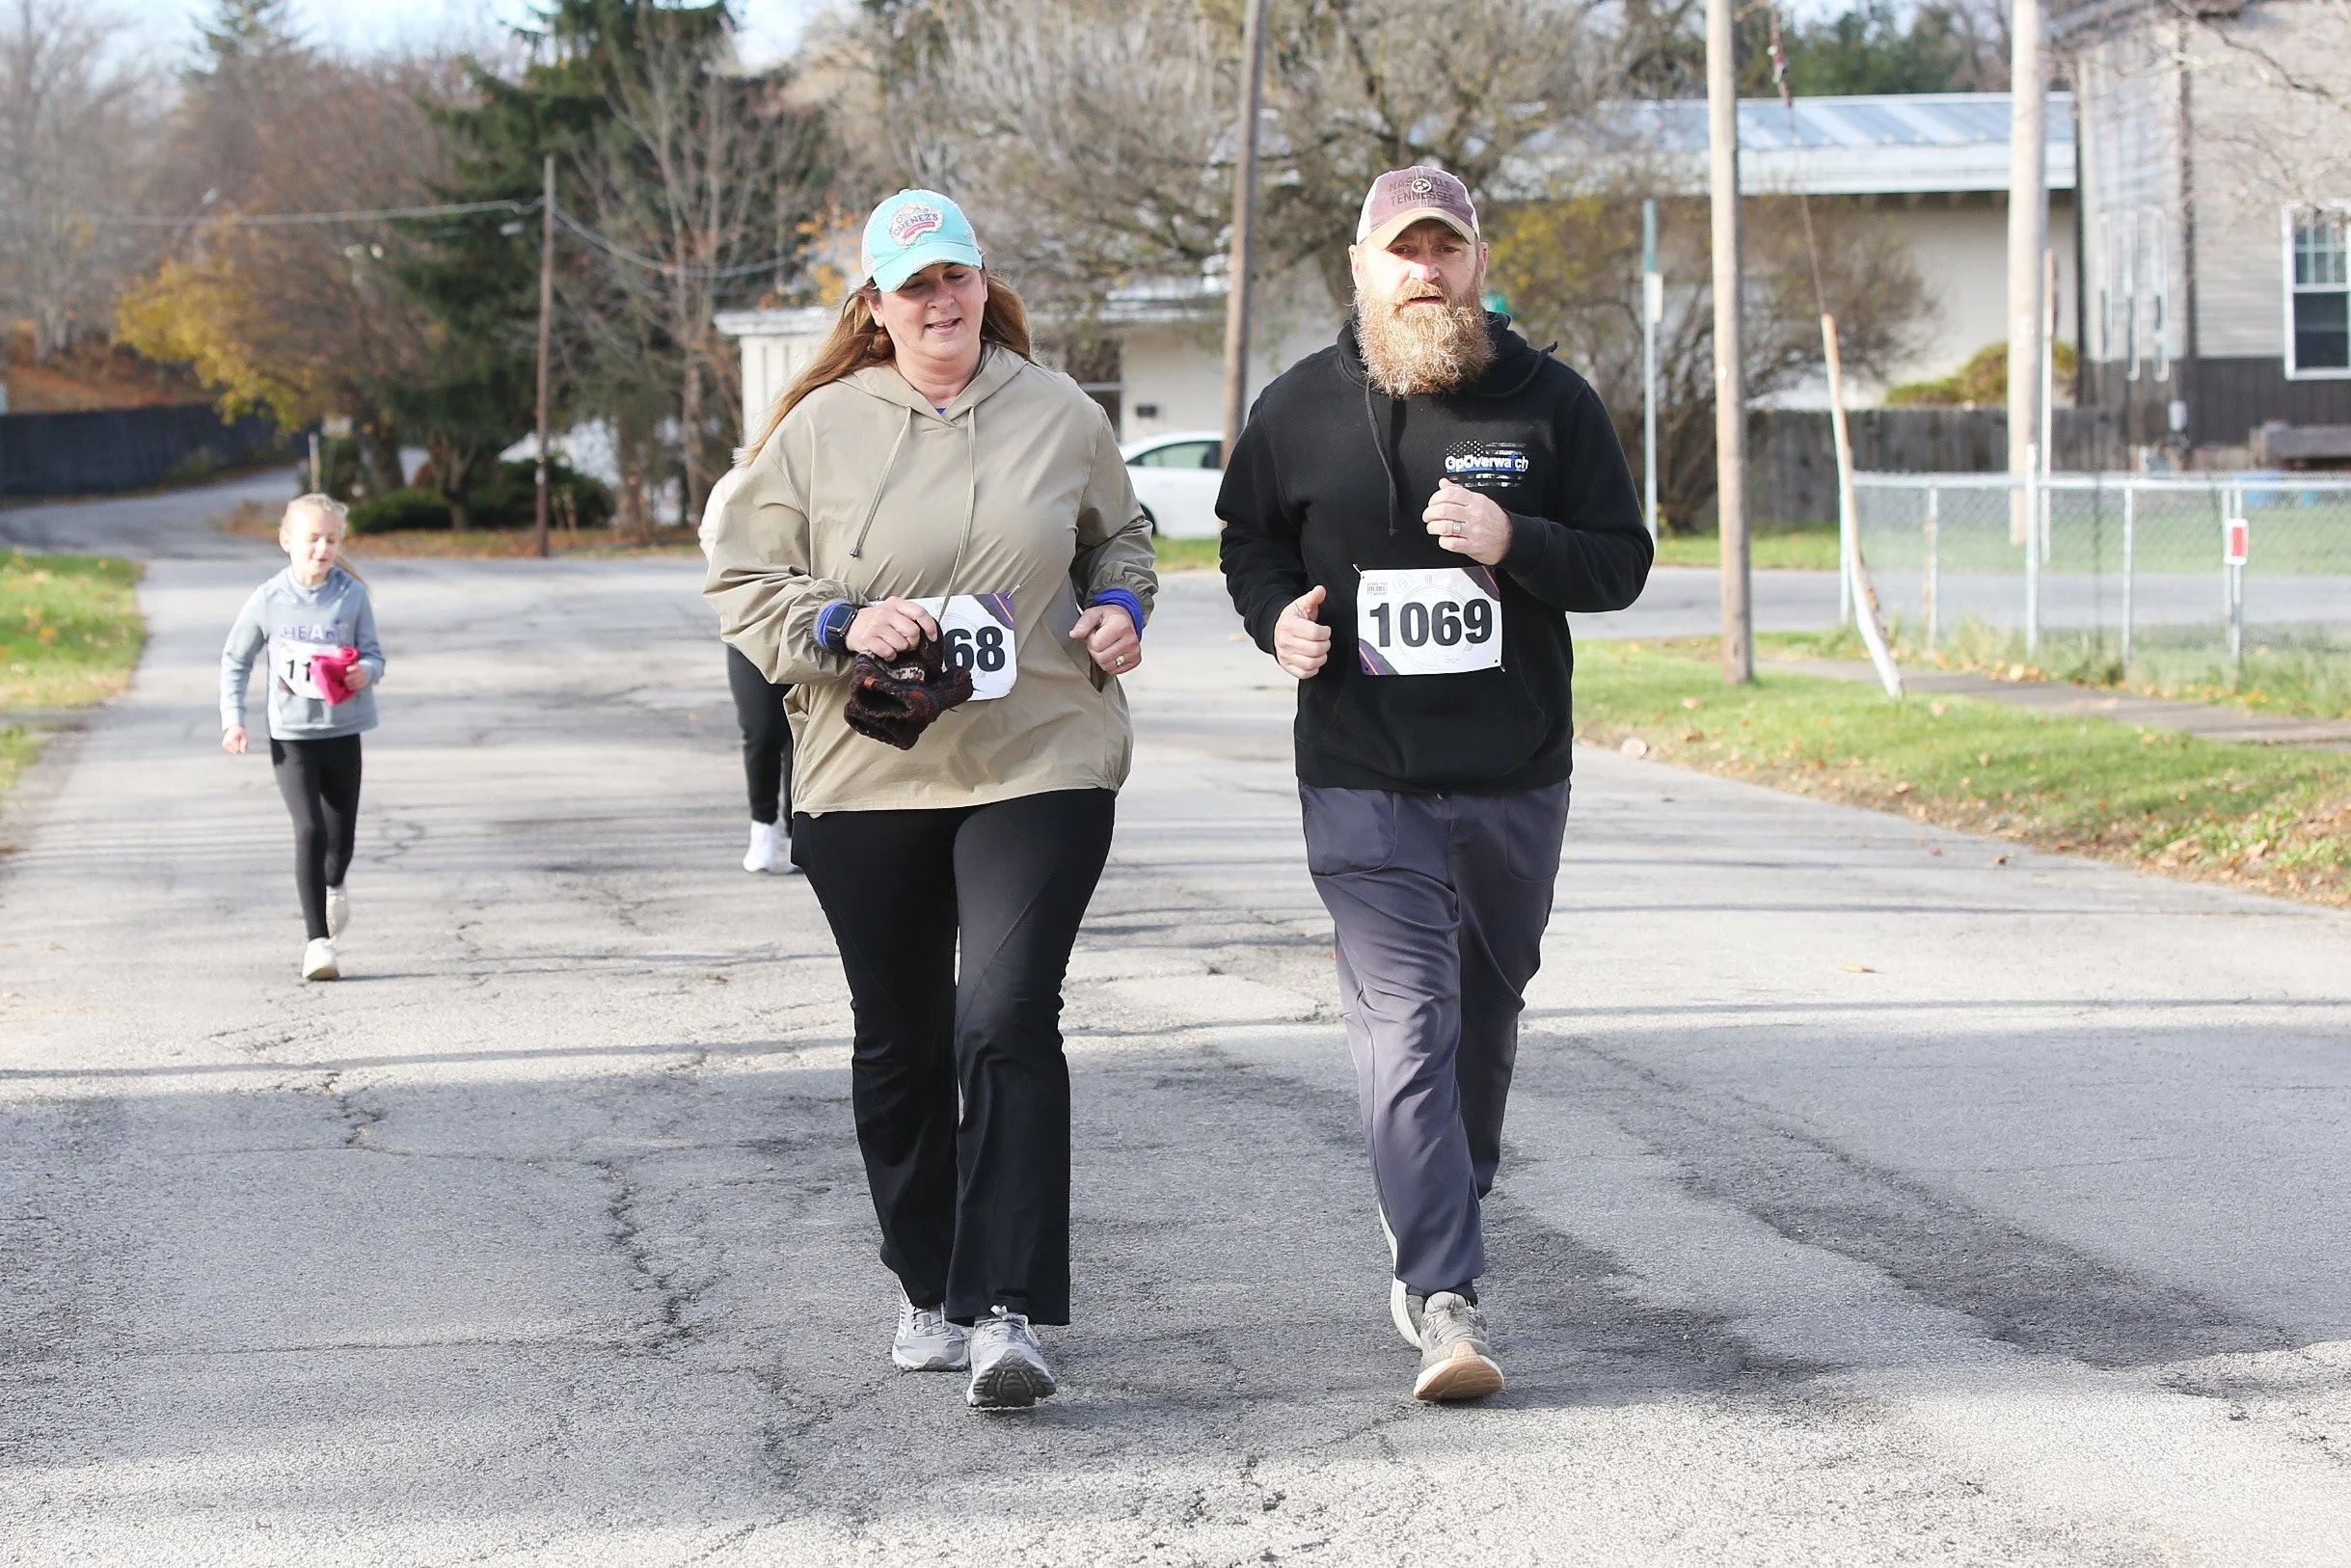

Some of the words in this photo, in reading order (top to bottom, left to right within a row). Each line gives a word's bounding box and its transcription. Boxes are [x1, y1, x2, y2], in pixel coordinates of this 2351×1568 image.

[1390, 192, 1457, 206] TENNESSEE
[1369, 598, 1493, 648] 1069
[944, 626, 1006, 672] 68
[285, 659, 311, 682] 11
